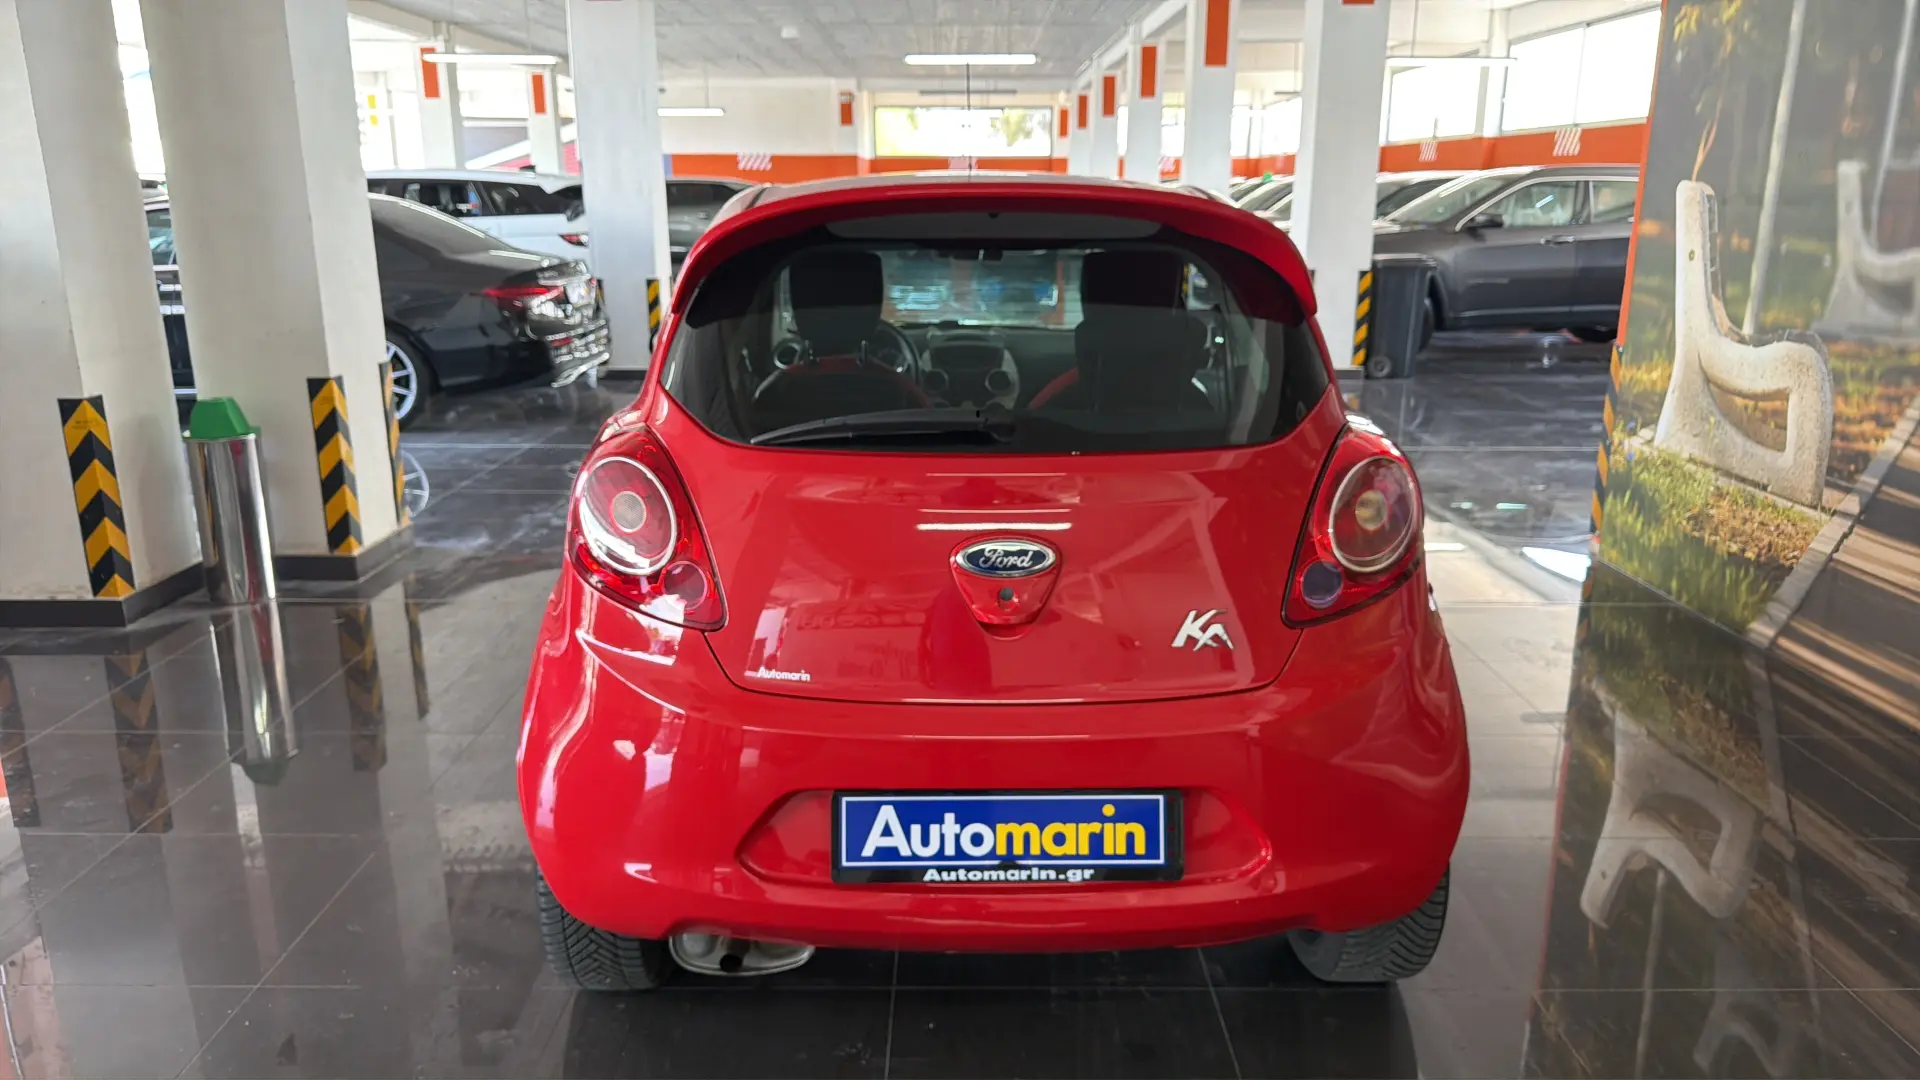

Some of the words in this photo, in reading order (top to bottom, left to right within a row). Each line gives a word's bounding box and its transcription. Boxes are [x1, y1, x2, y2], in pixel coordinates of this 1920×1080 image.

[978, 546, 1034, 569] Ford
[757, 666, 811, 682] Automarin
[860, 803, 1146, 858] Automarin
[923, 867, 1095, 883] Automarin.gr
